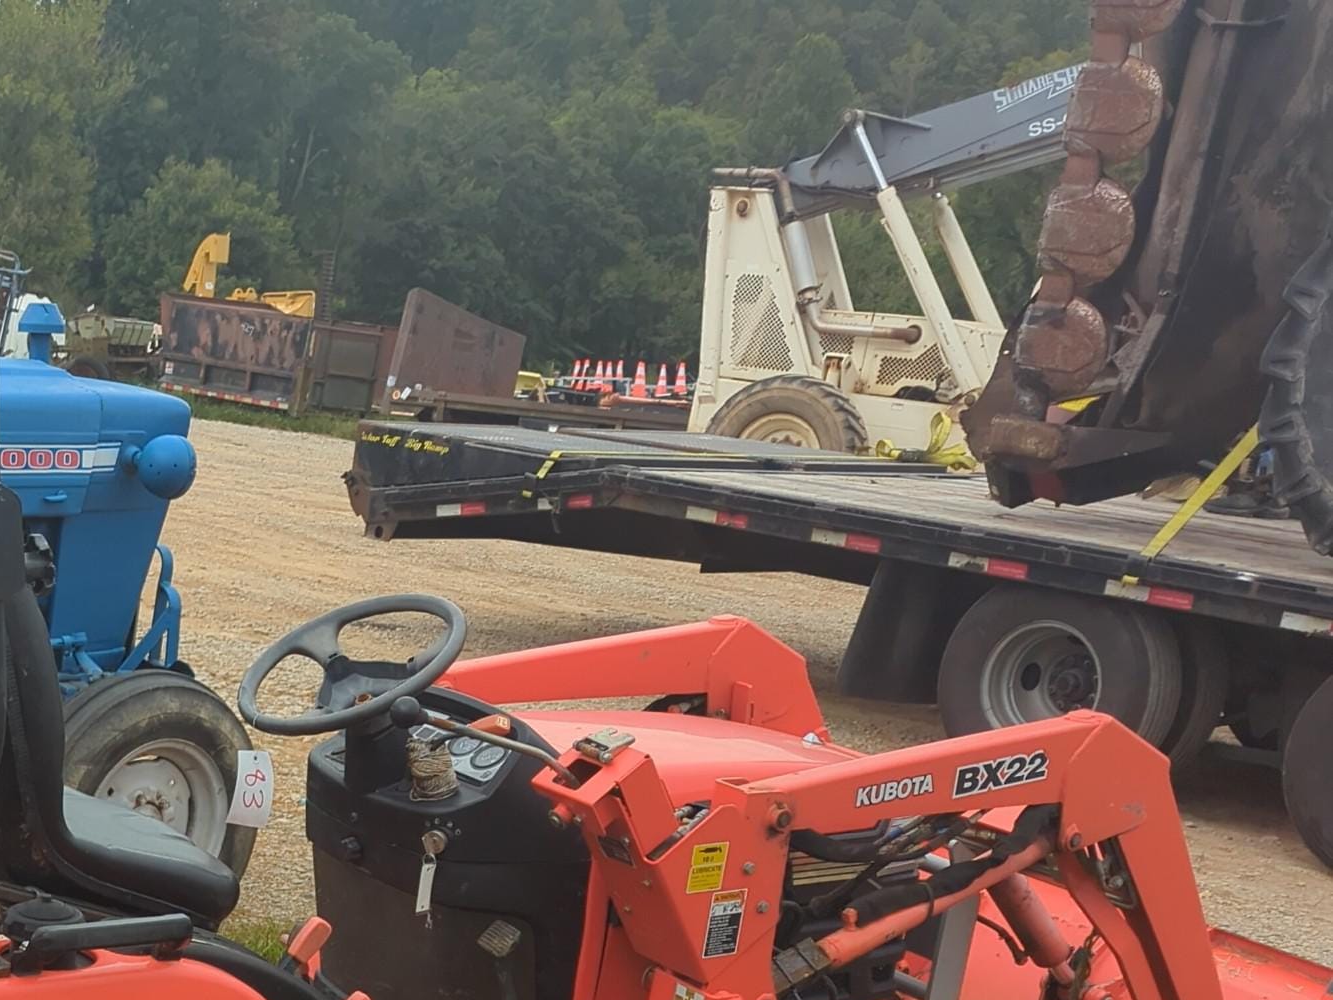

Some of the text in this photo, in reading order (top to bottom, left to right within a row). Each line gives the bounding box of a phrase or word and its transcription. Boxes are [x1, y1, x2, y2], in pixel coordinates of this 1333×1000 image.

[1028, 114, 1067, 136] SS-
[0, 449, 81, 470] 000
[243, 769, 266, 809] 83
[855, 750, 1049, 807] KUBOTA BX22
